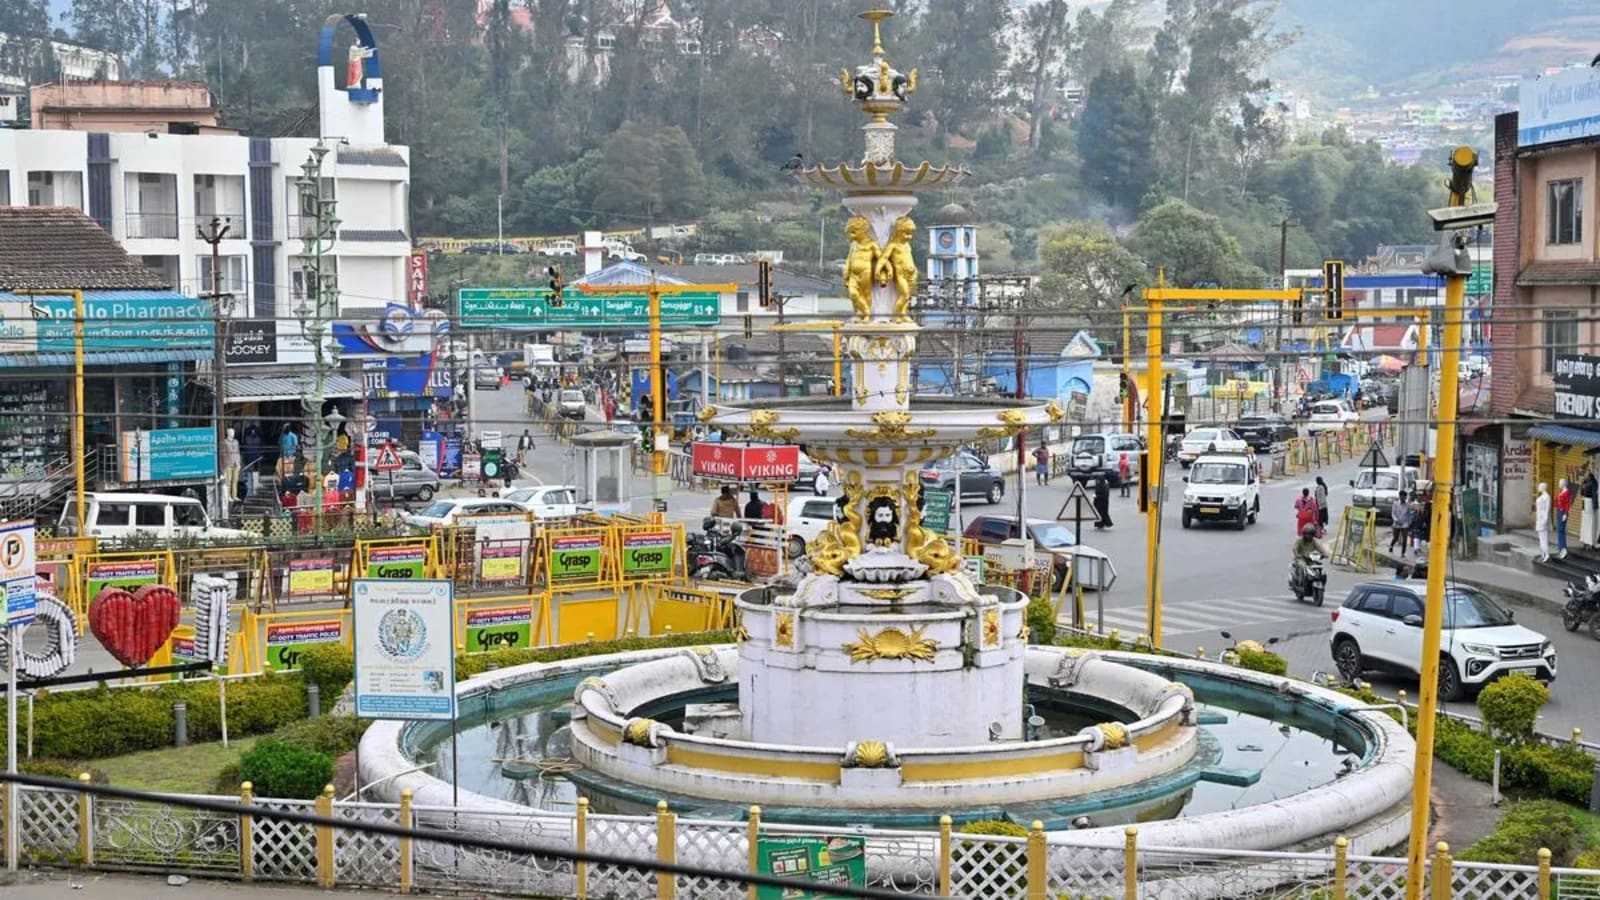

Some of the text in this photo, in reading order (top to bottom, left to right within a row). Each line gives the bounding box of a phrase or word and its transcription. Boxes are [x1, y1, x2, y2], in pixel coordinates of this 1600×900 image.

[112, 303, 206, 320] Pharmacy
[634, 305, 644, 316] 27
[1, 325, 24, 337] ollo
[226, 344, 271, 356] JOCKEY
[1555, 392, 1595, 418] TRENDY
[701, 460, 735, 475] VIKING
[749, 463, 793, 476] VIKING
[295, 632, 320, 640] TRAFFIC
[320, 630, 339, 638] POLICE
